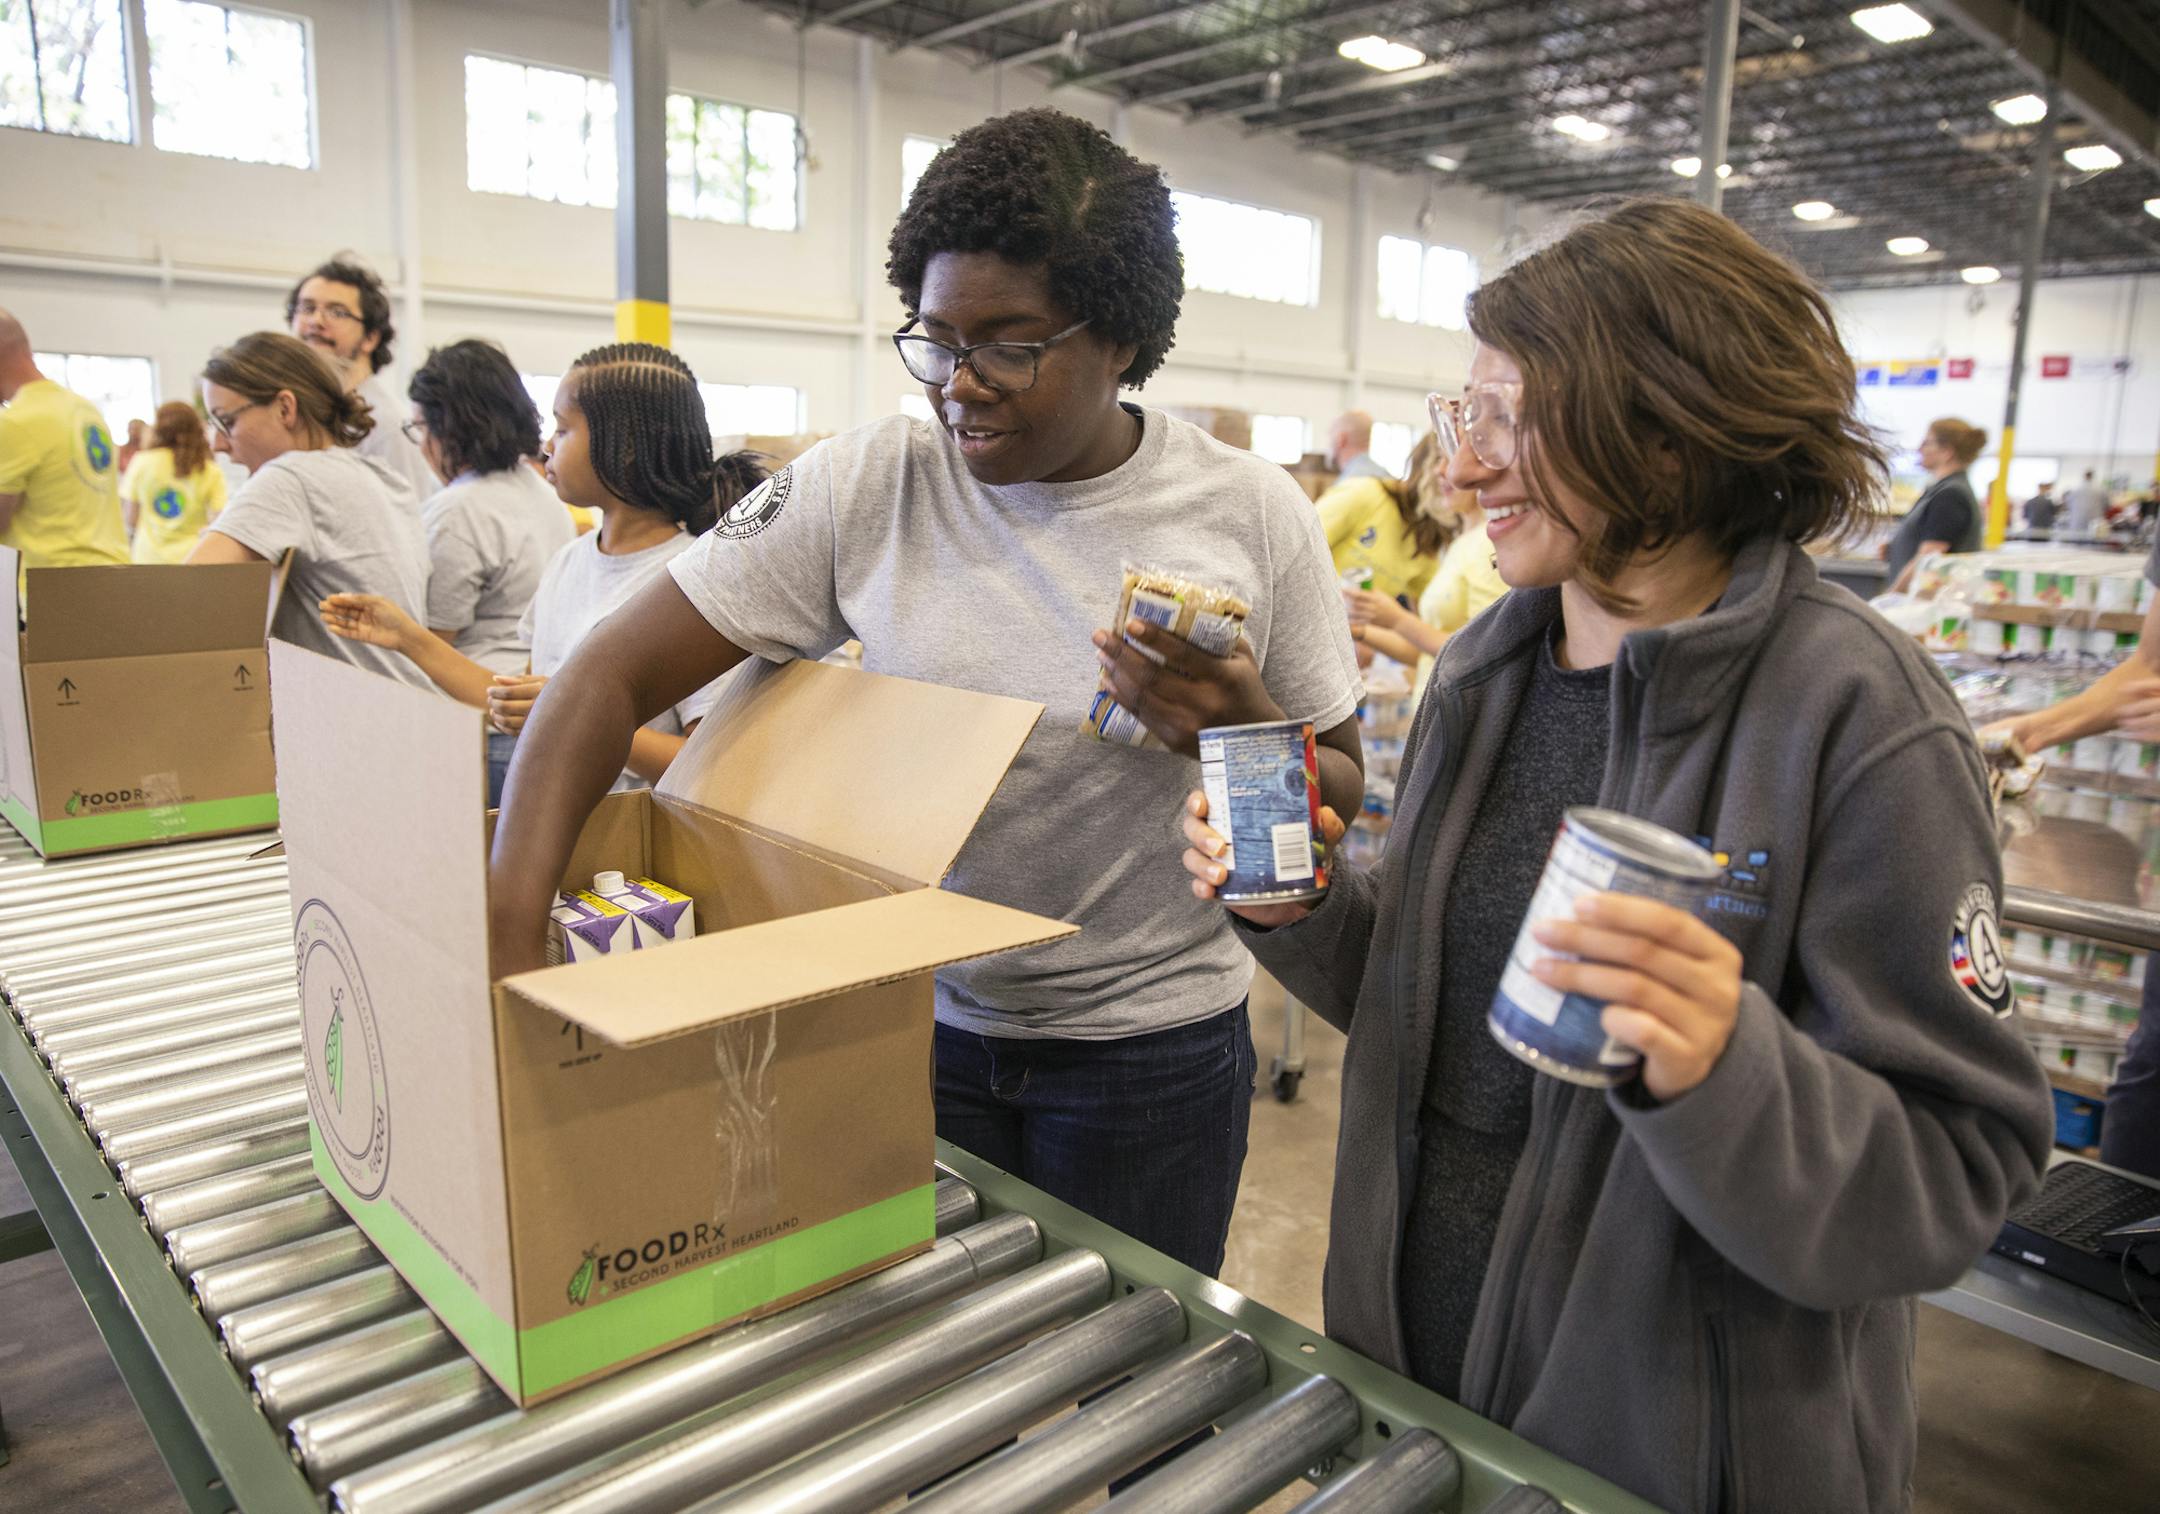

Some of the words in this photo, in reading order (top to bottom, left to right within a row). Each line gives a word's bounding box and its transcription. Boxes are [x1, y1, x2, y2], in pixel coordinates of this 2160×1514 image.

[612, 1264, 670, 1292] SECOND
[675, 1241, 727, 1270] HARVEST
[732, 1217, 800, 1248] HEARTLAND
